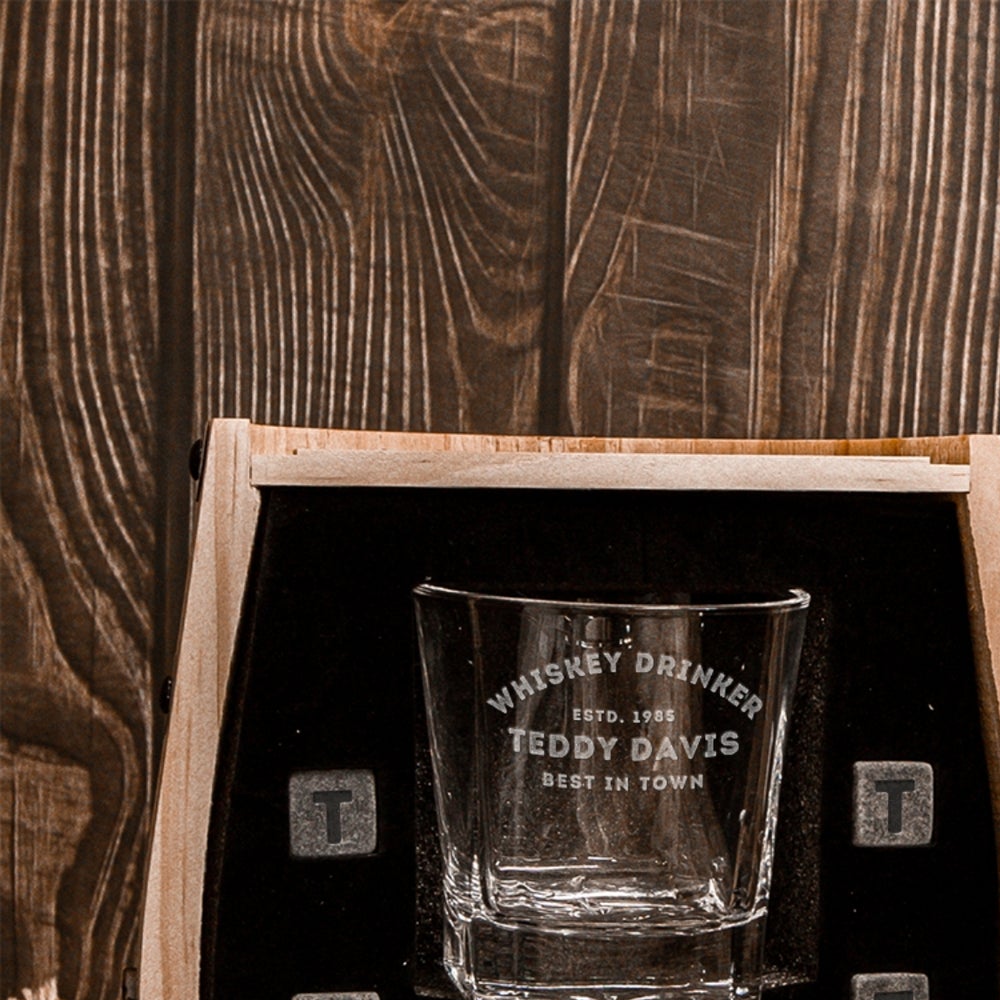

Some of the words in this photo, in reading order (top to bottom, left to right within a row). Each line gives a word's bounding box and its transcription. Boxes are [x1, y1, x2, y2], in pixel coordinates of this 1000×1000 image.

[486, 652, 622, 714] WHISKEY
[635, 652, 764, 720] DRINKER
[572, 709, 625, 723] ESTD.
[632, 709, 675, 723] 1985
[508, 727, 618, 760] TEDDY
[631, 731, 740, 762] DAVIS
[542, 772, 595, 789] BEST
[604, 776, 629, 791] IN
[639, 774, 704, 791] TOWN
[313, 790, 352, 844] T
[875, 779, 915, 833] T
